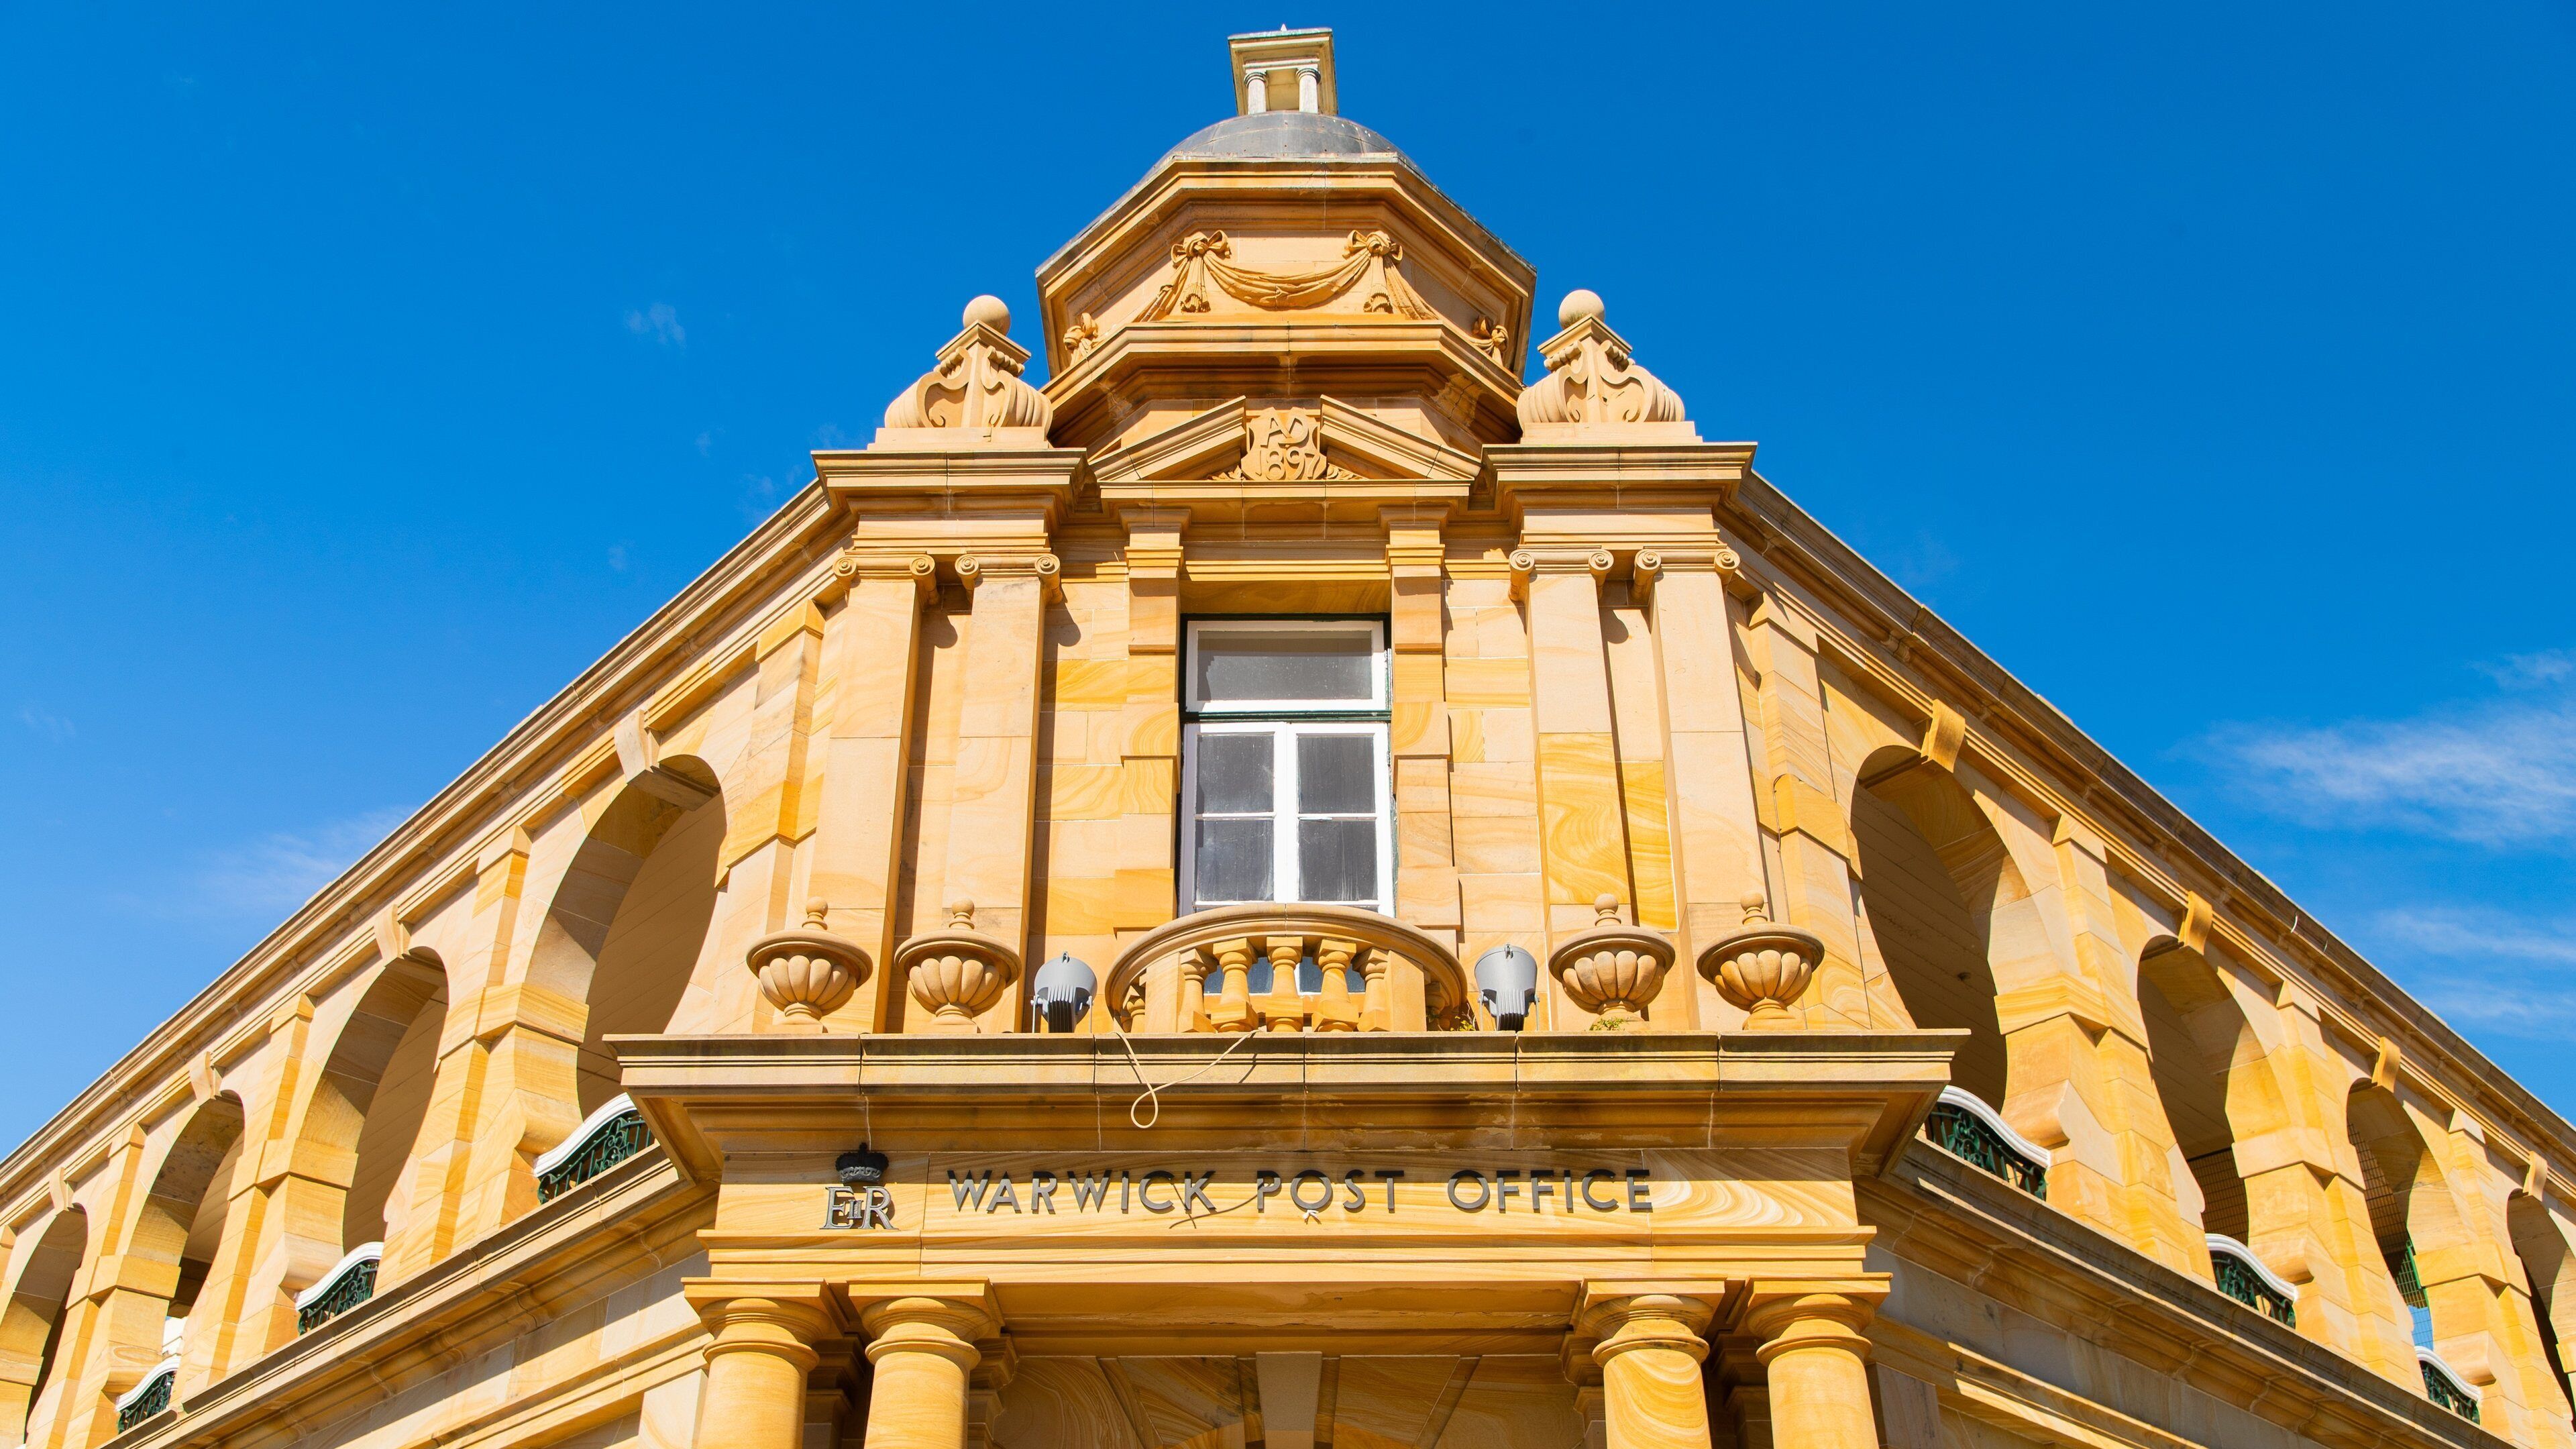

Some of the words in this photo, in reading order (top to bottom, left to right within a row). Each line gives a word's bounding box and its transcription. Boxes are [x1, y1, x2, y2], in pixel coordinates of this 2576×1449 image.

[1260, 409, 1309, 447] AD
[1254, 447, 1320, 480] 1897
[947, 1169, 1216, 1214] WARWICK
[1256, 1169, 1404, 1214] POST
[1447, 1169, 1653, 1213] OFFICE
